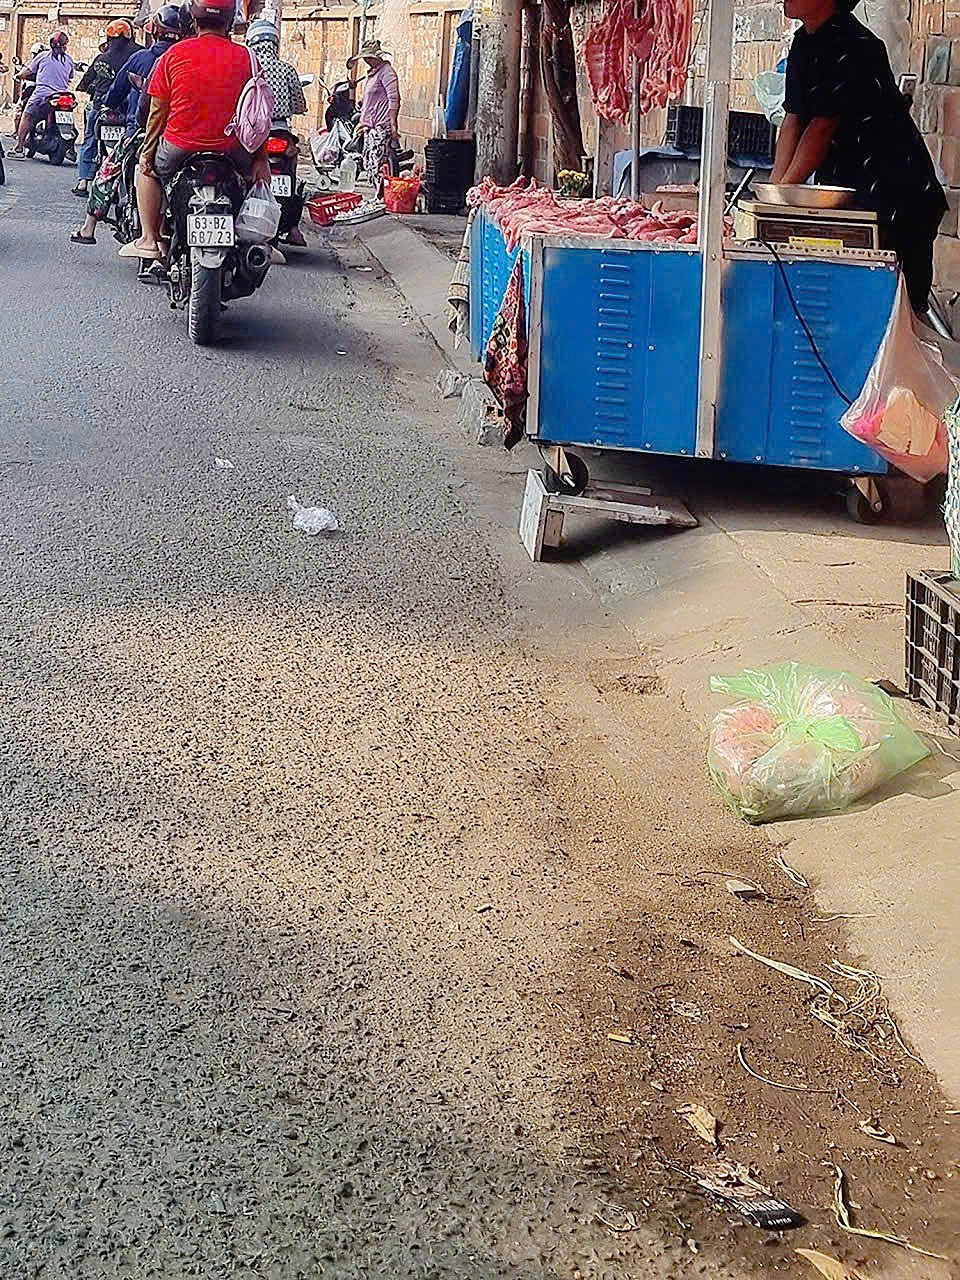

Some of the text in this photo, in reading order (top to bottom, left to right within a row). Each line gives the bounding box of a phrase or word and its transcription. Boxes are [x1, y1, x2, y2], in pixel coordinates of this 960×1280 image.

[273, 177, 286, 186] -TA
[194, 217, 226, 230] 63-B2
[191, 231, 232, 244] 687.23
